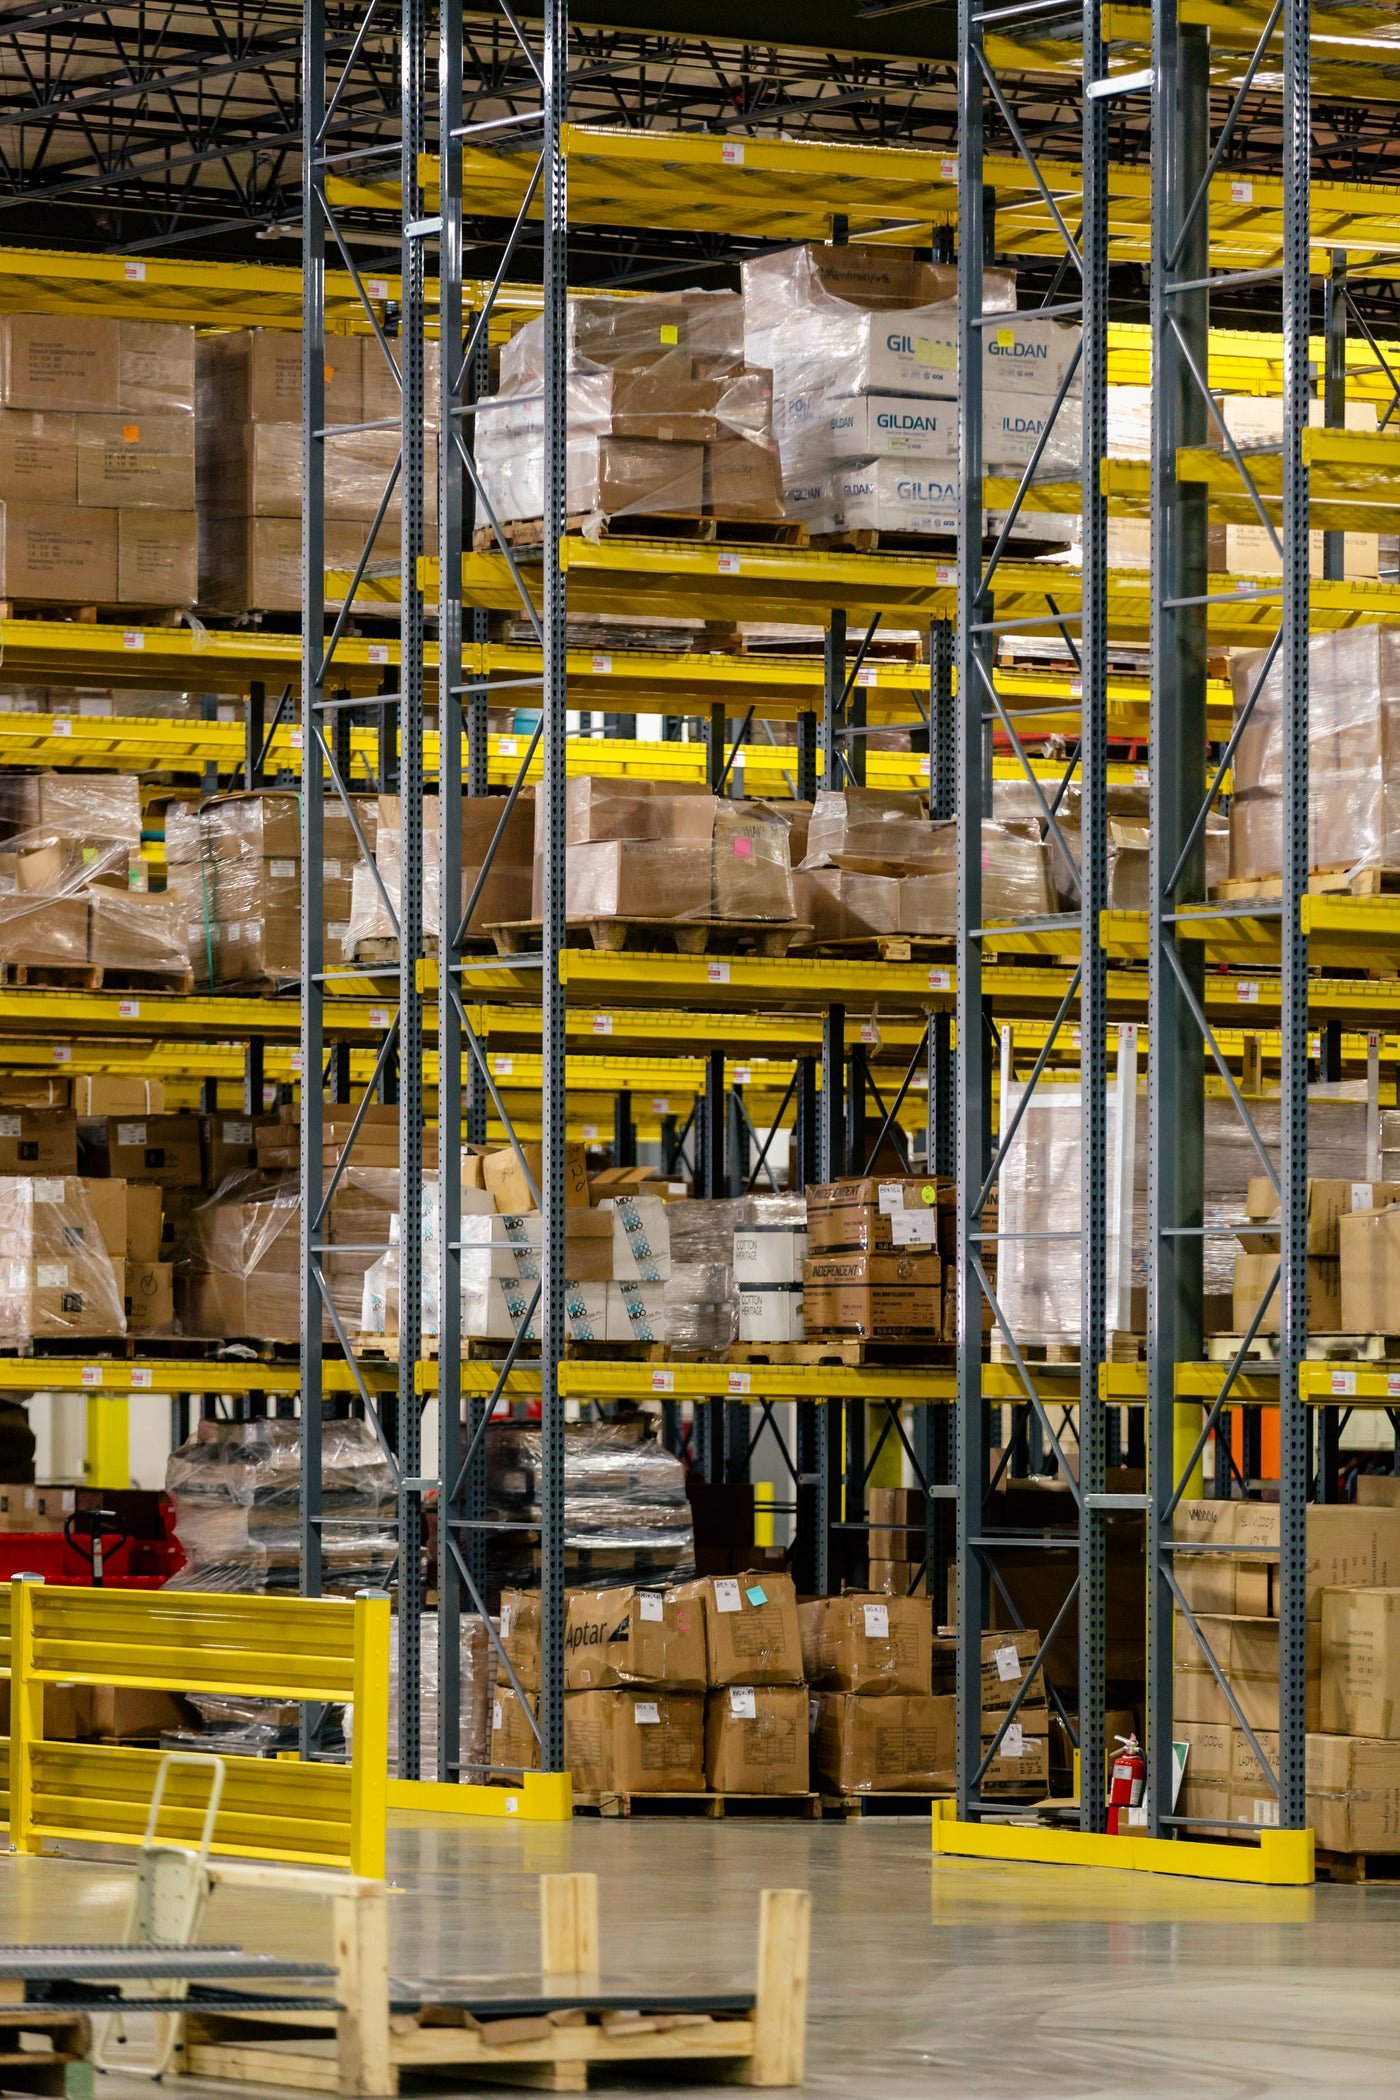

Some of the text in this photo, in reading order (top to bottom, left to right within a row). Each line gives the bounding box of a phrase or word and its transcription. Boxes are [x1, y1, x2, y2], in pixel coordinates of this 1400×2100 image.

[988, 341, 1048, 358] GILDAN
[877, 413, 937, 431] GILDAN
[897, 482, 957, 502] GILDA
[616, 1196, 633, 1207] MIDO
[505, 1219, 523, 1231] MIDO
[625, 1221, 643, 1233] MIDO
[736, 1240, 757, 1250] COTTON
[514, 1248, 532, 1259] MIDO
[635, 1249, 652, 1261] MIDO
[736, 1251, 757, 1261] HERITAGE
[812, 1265, 859, 1278] INDEPENDENT
[621, 1282, 637, 1294] MIDO
[742, 1295, 763, 1305] COTTON
[509, 1307, 527, 1319] MIDO
[569, 1309, 587, 1320] MIDO
[629, 1309, 646, 1321] MIDO
[742, 1306, 763, 1316] HERITAGE
[566, 1622, 608, 1656] Aptar
